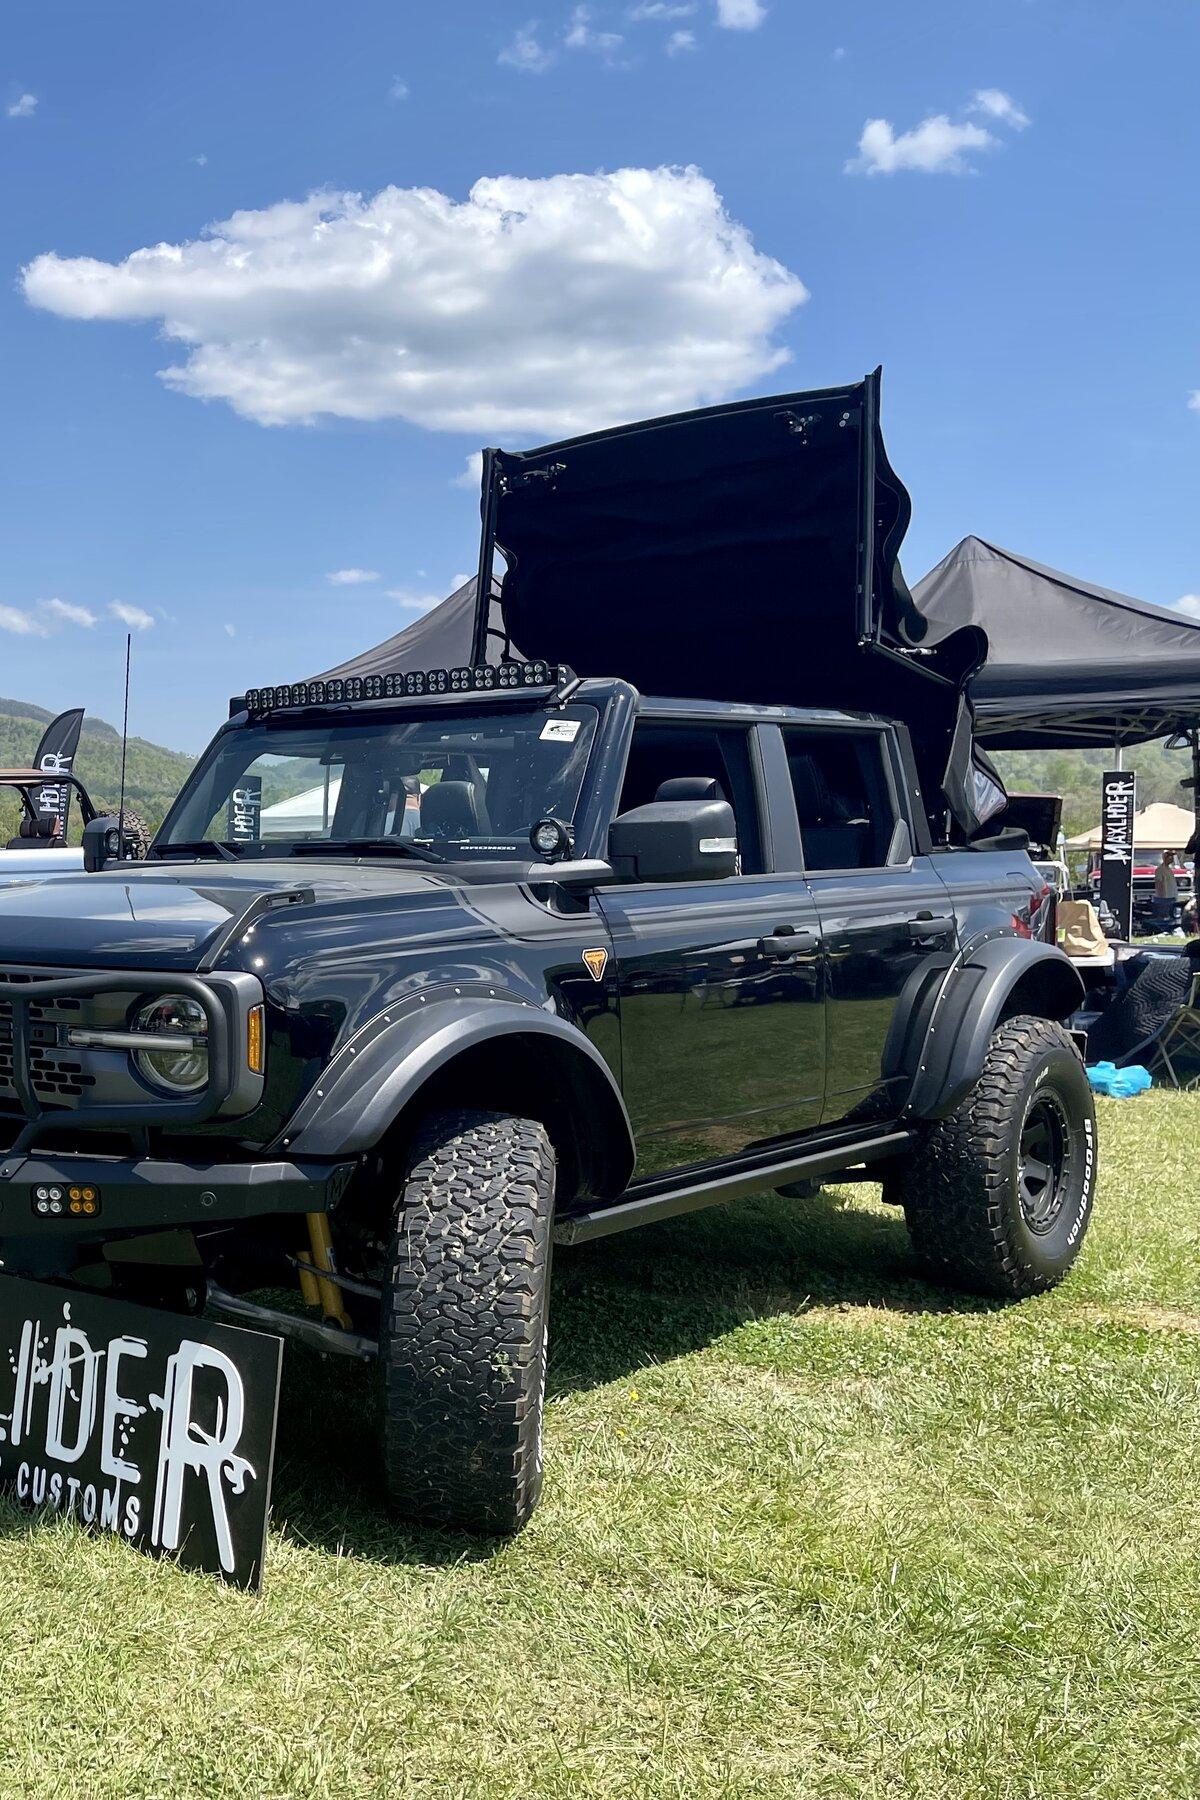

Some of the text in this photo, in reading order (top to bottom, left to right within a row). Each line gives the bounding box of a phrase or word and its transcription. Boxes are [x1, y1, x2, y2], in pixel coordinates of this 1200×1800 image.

[1103, 781, 1134, 865] MAXLIDER
[1067, 1118, 1093, 1246] BFGoodrich
[16, 1461, 141, 1537] CUSTOMS
